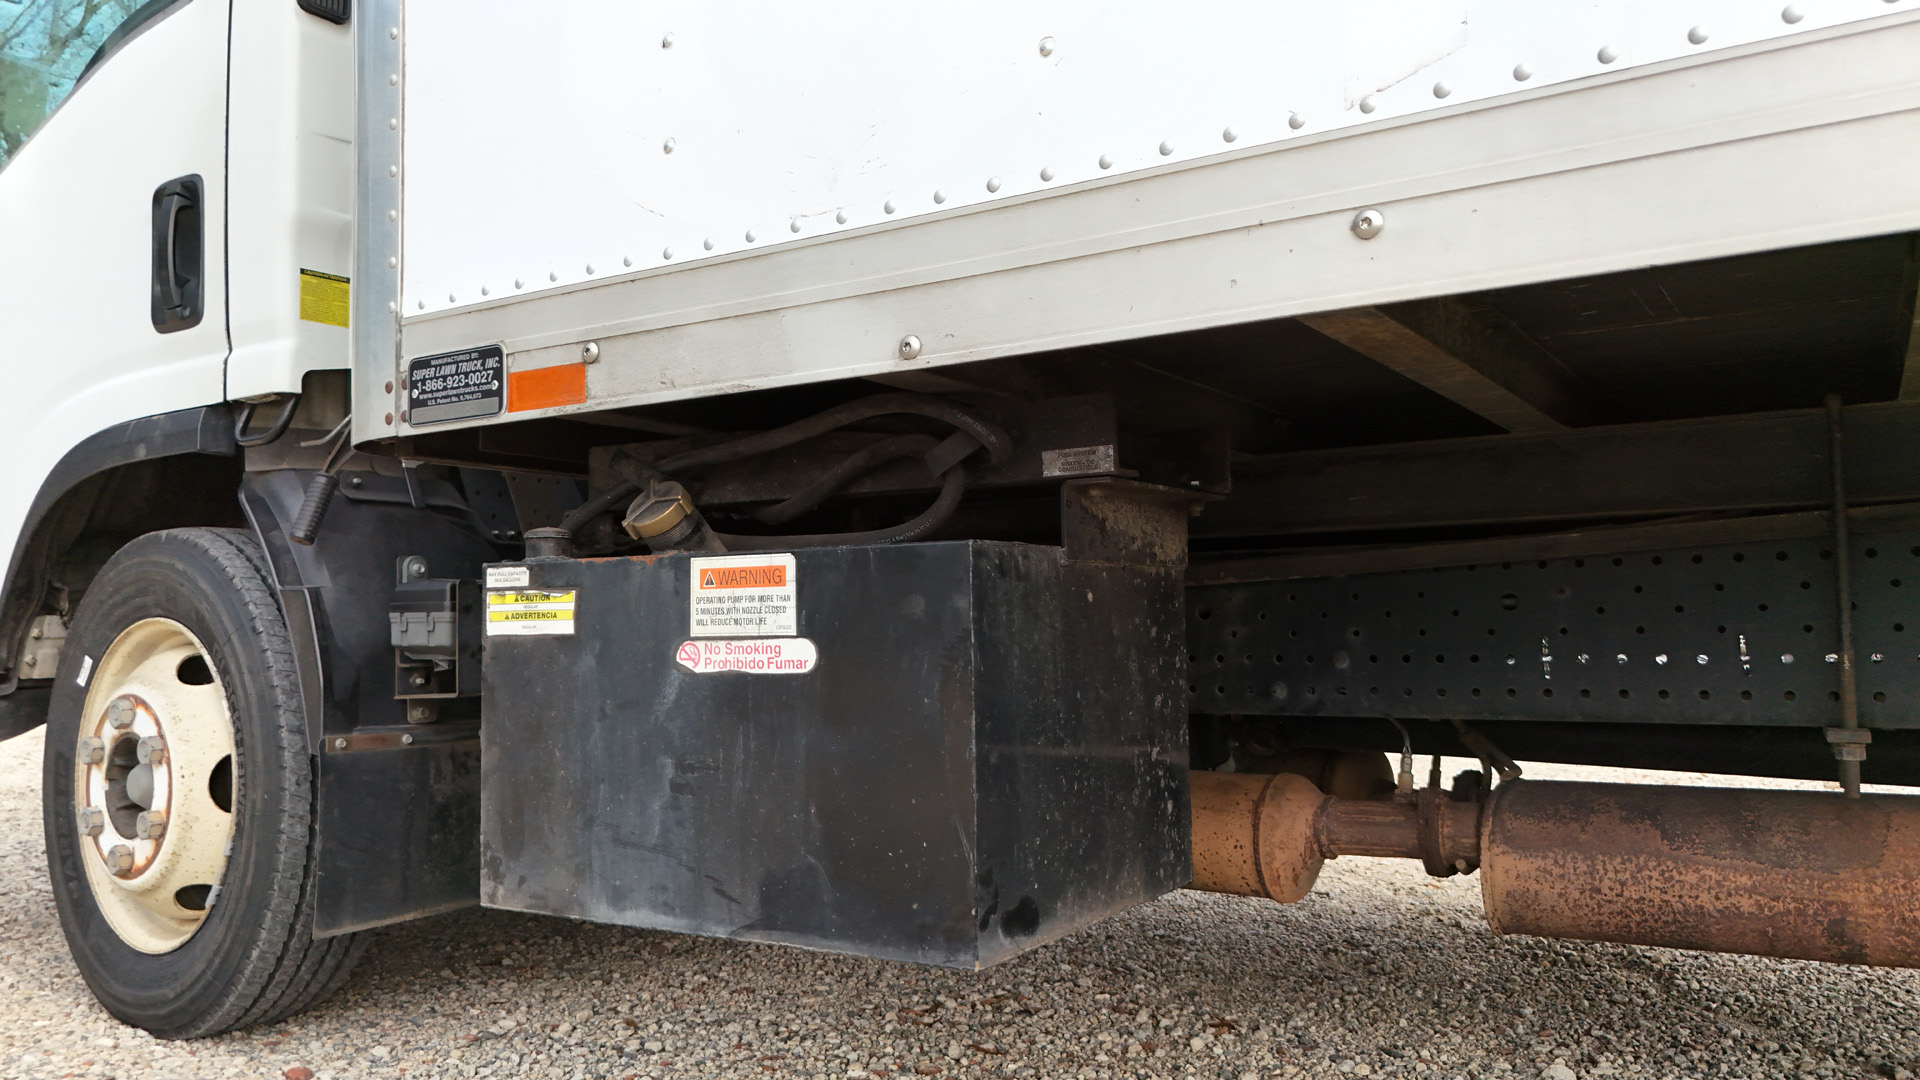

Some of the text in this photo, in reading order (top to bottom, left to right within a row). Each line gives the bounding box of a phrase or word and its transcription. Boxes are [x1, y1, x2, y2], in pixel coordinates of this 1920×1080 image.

[430, 353, 470, 365] MANUFACTURED
[412, 356, 501, 381] SUPER LAWN TRUCK, INC.
[417, 369, 494, 393] 1-866-923-0027
[419, 384, 492, 400] www.superlawntrucks.com
[437, 397, 451, 405] Patent
[718, 568, 782, 586] WARNING
[520, 593, 551, 602] CAUTION
[696, 594, 791, 605] OPERATING PUMP FOR MORE THAN
[511, 612, 558, 620] ADVERTENCIA
[700, 607, 725, 616] MINUTES
[726, 606, 741, 615] WITH
[741, 605, 763, 615] NOZZLE
[764, 605, 787, 614] CLOSED
[695, 617, 767, 627] WILL REDUCE MOTOR LIFE
[704, 642, 782, 658] No Smoking
[704, 657, 809, 670] Prohibido Fumar
